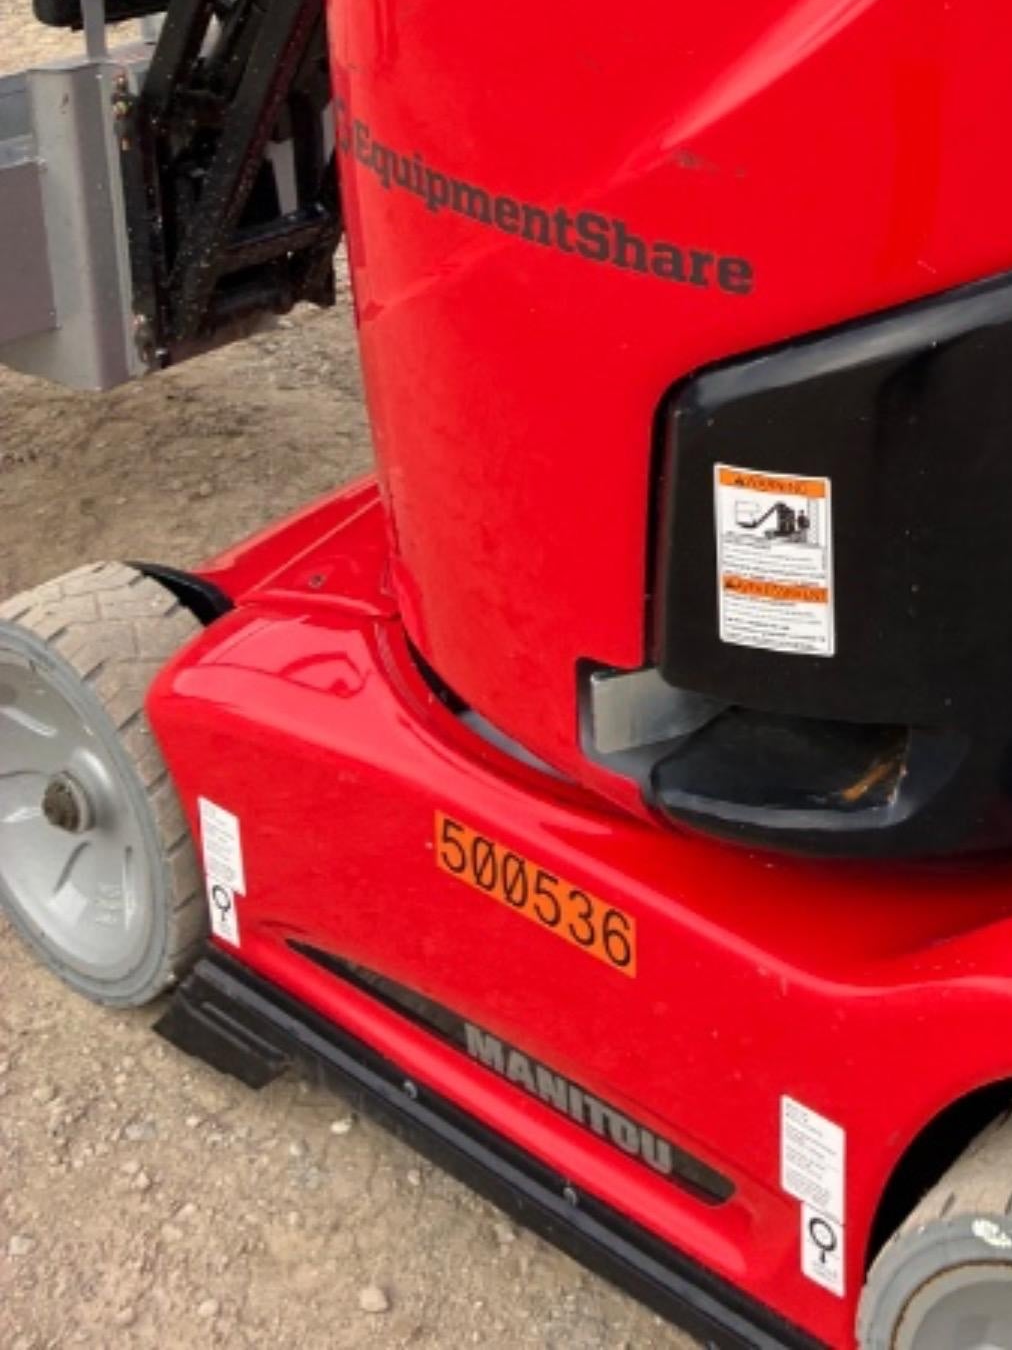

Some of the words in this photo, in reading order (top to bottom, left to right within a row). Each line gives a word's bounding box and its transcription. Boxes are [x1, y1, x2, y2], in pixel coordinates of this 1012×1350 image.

[352, 119, 755, 296] EquipmentShare
[440, 817, 631, 968] 500536
[463, 1022, 672, 1175] MANITOU
